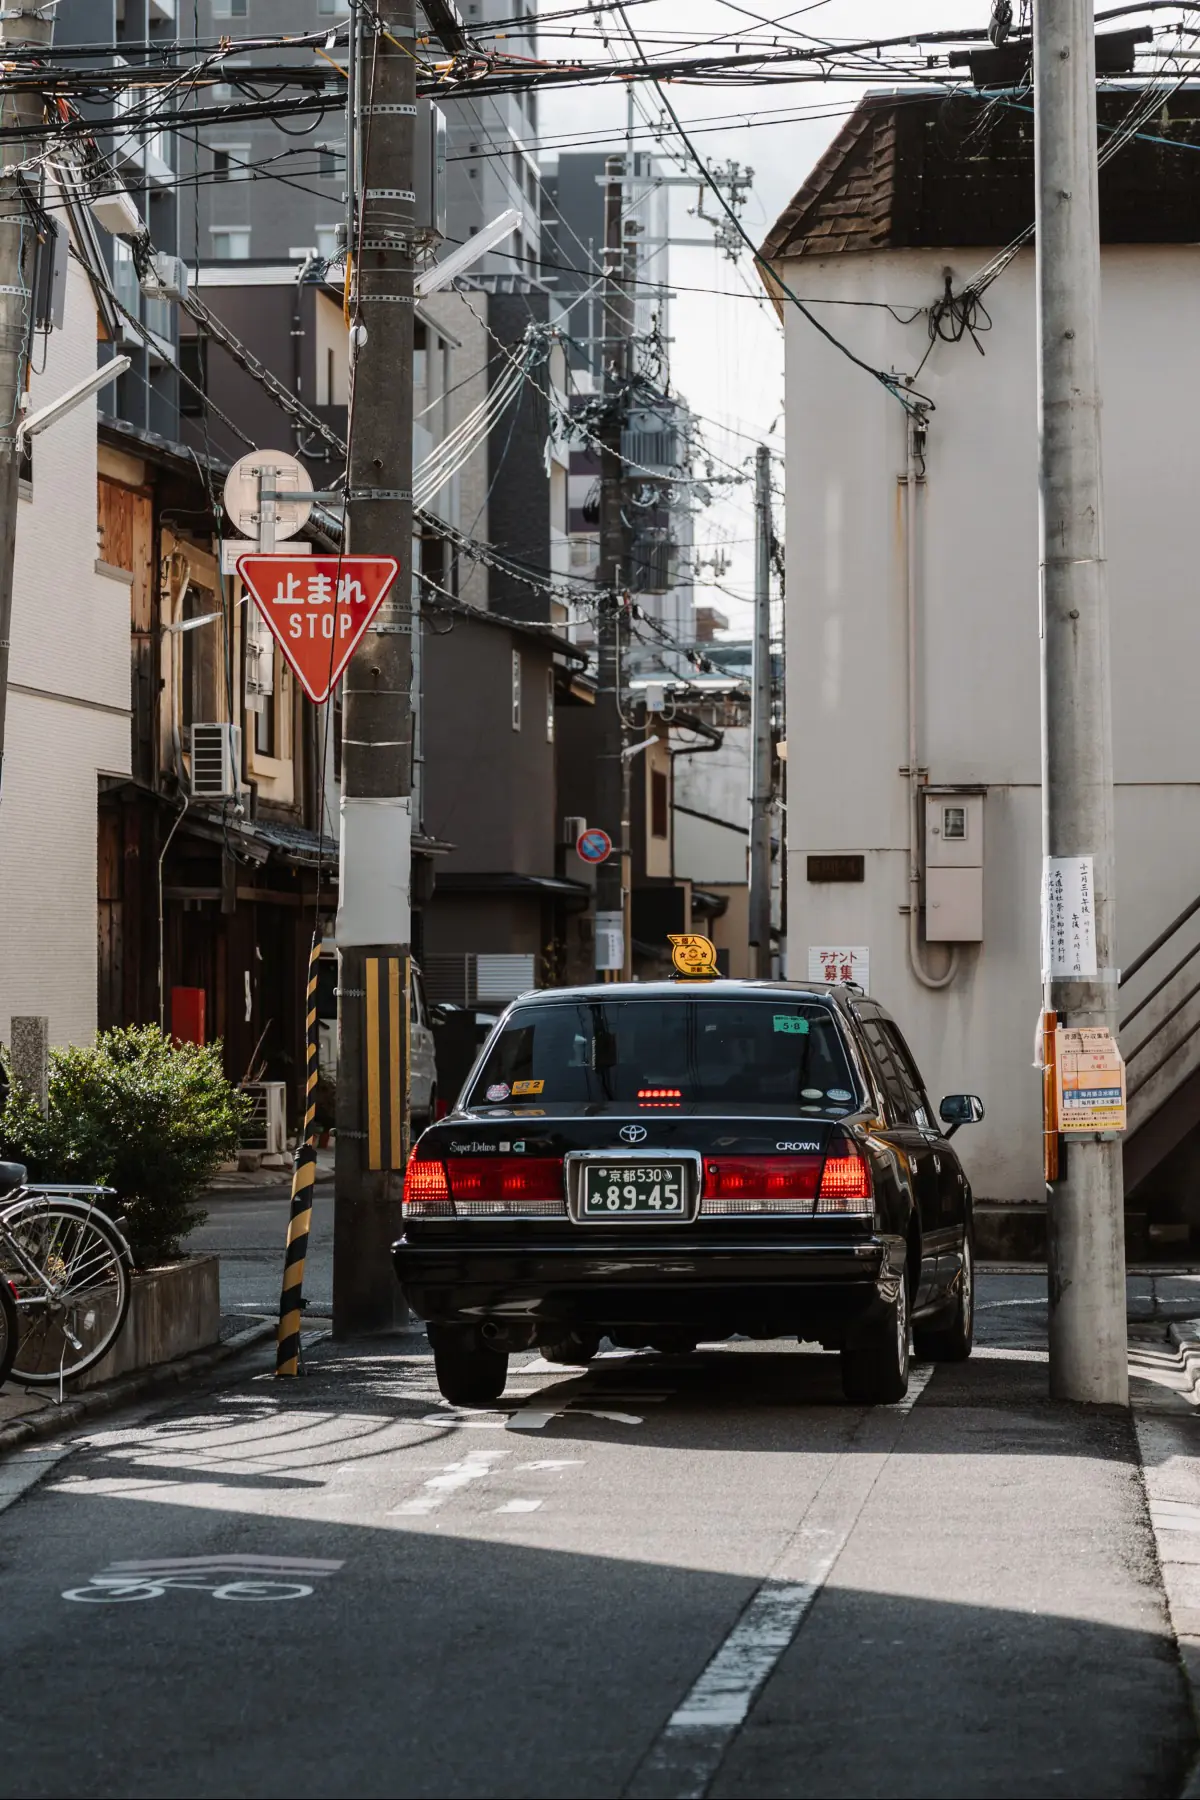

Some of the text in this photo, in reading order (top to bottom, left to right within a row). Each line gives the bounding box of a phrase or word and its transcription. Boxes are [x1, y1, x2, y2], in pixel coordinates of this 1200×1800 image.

[272, 572, 366, 605] 止まれ
[289, 613, 353, 639] STOP
[820, 951, 858, 964] テナント
[824, 964, 853, 981] 募集
[449, 1141, 497, 1155] Super Deluxe
[775, 1141, 820, 1151] CROWN
[590, 1184, 679, 1211] あ 89-45
